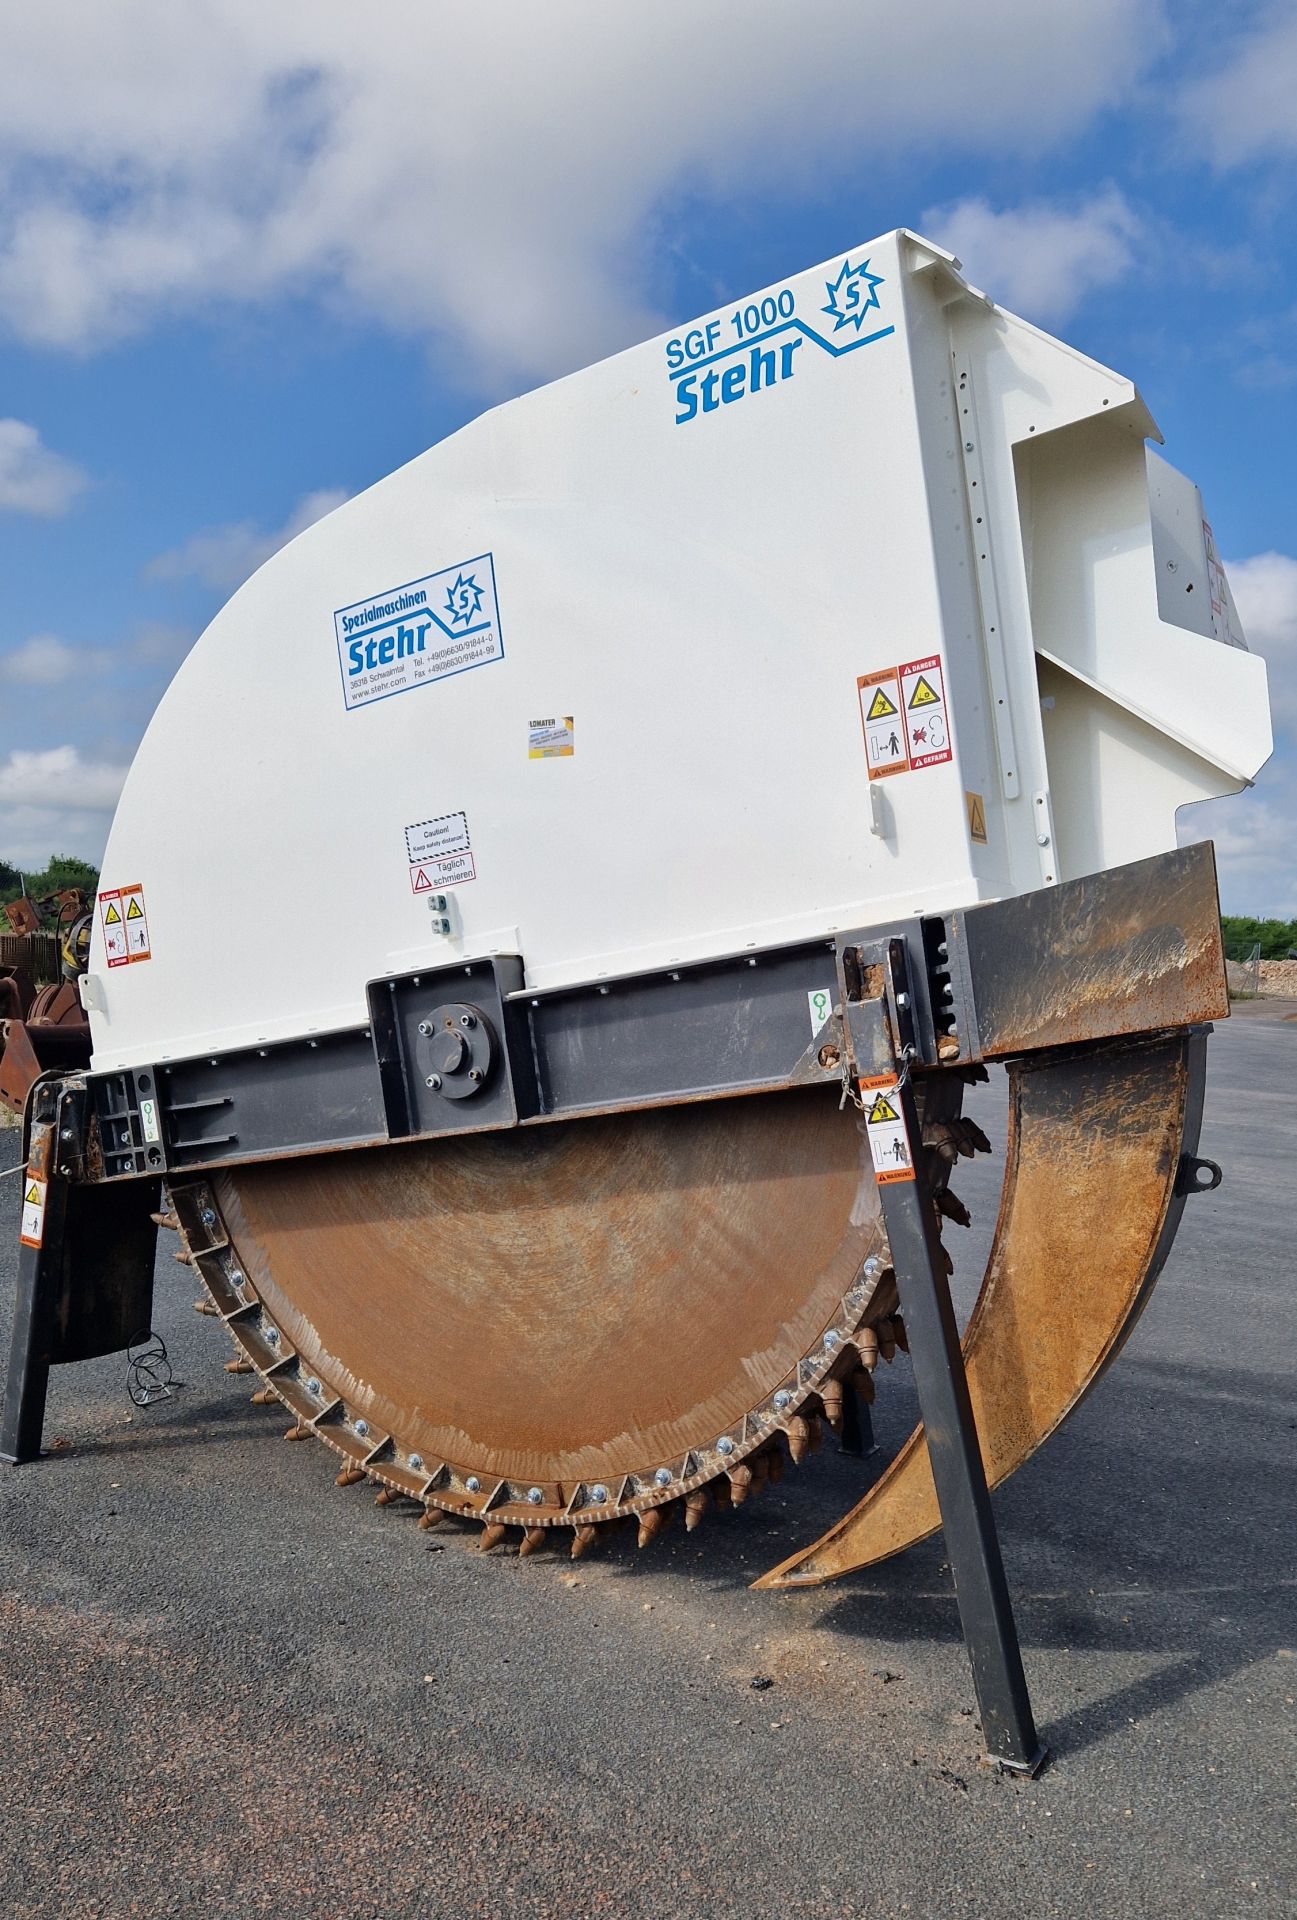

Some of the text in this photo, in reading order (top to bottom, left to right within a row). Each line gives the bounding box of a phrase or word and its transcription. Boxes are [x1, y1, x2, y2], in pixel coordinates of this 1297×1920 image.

[845, 280, 860, 310] S
[666, 289, 795, 369] SGF 1000
[675, 337, 803, 425] Stehr
[342, 590, 427, 633] Spezialmaschinen
[348, 622, 432, 676] Stehr
[413, 658, 425, 667] Tel.
[911, 659, 937, 672] DANGER
[350, 665, 405, 690] 36318 Schwalmtal
[414, 669, 426, 679] Fax
[351, 676, 407, 700] www.stehr.com
[923, 752, 948, 764] GEFAHR
[424, 826, 449, 838] Caution!
[437, 858, 465, 872] Täglich
[434, 870, 473, 885] schmieren
[870, 1078, 894, 1087] WARNING
